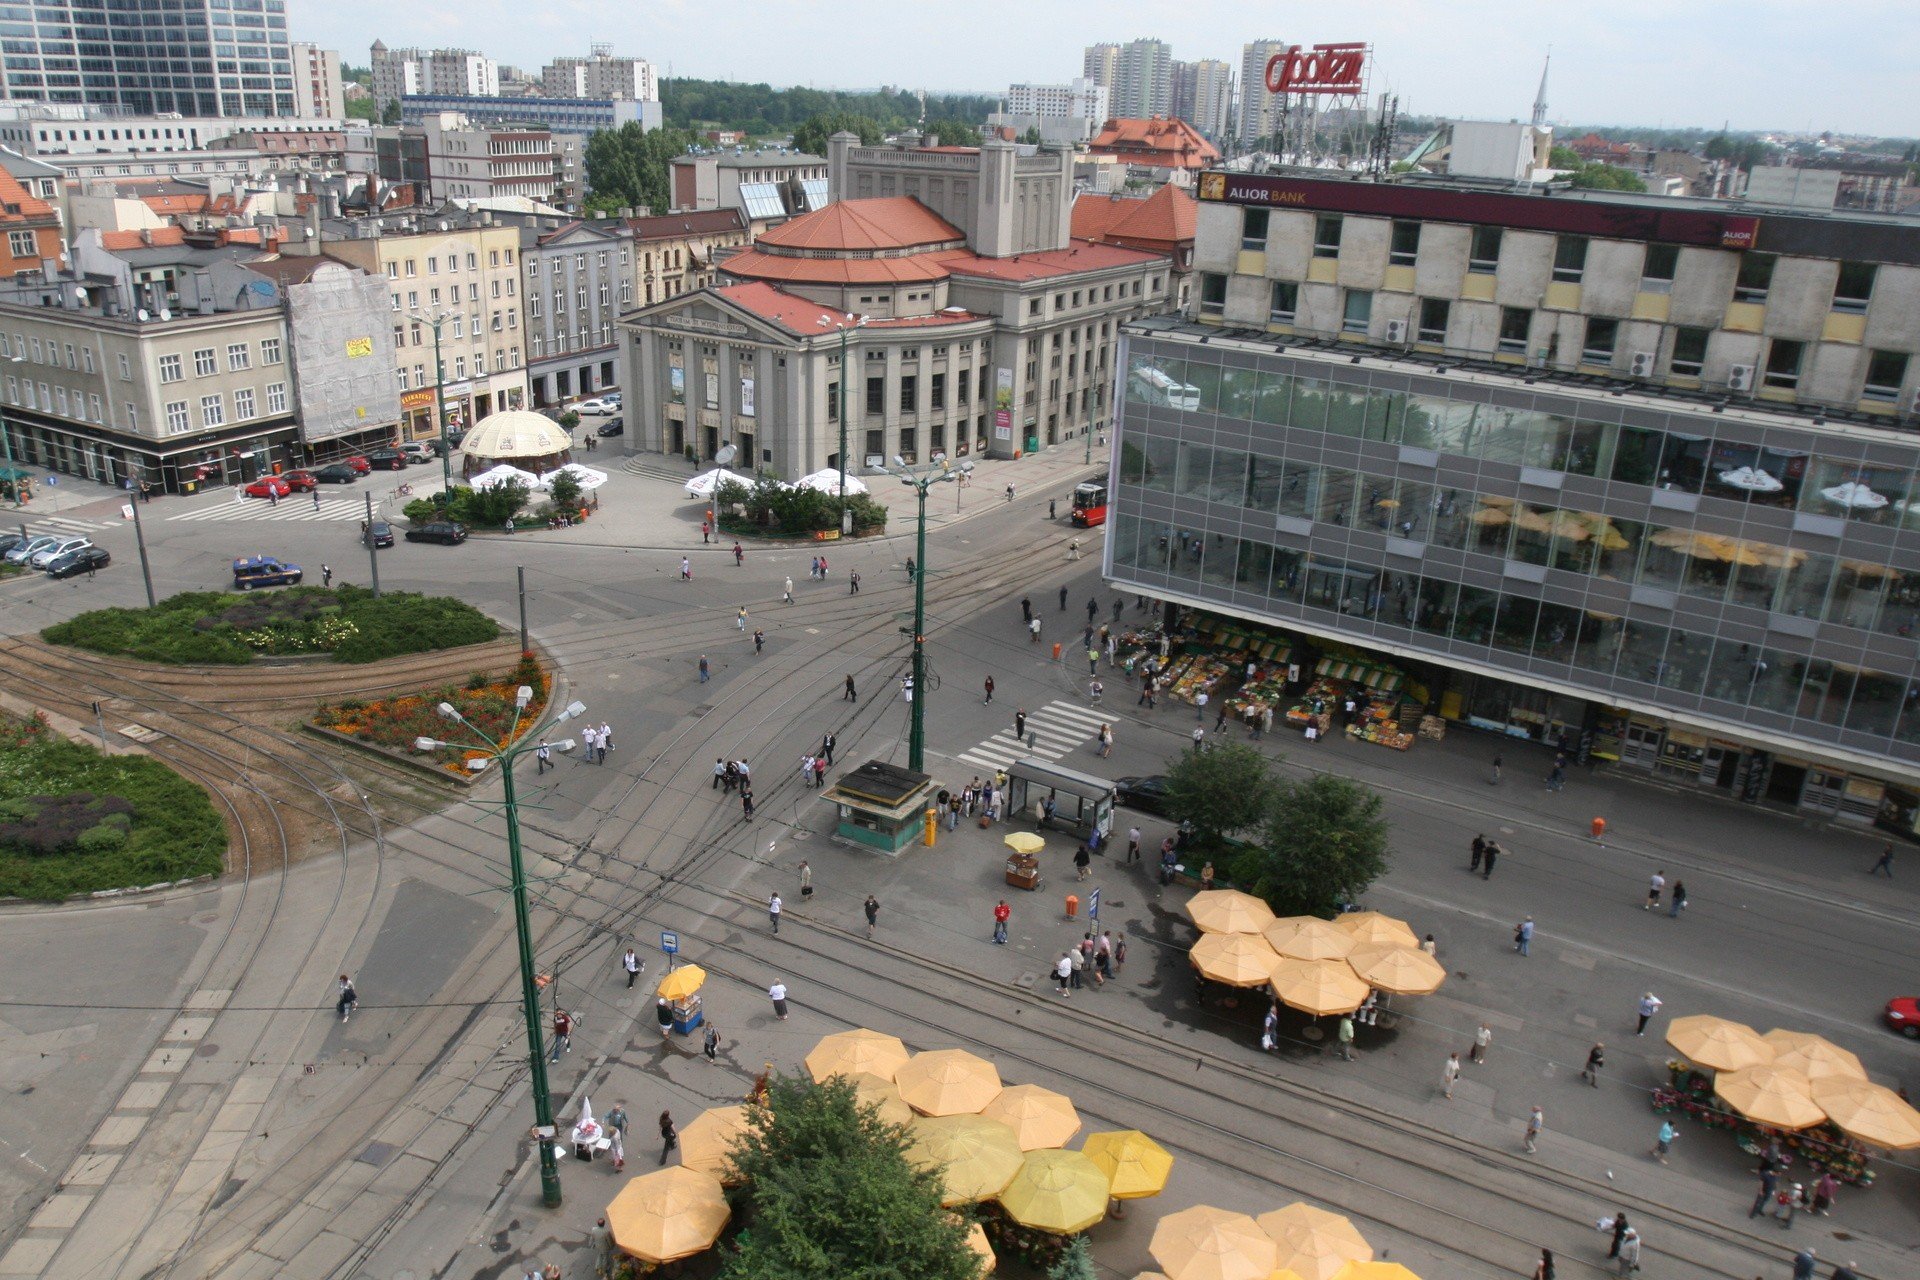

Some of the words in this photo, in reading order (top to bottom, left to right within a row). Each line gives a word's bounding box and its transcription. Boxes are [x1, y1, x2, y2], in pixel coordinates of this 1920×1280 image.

[1229, 187, 1269, 200] ALIOR
[1271, 190, 1306, 203] BANK
[1723, 231, 1751, 240] ALIOR
